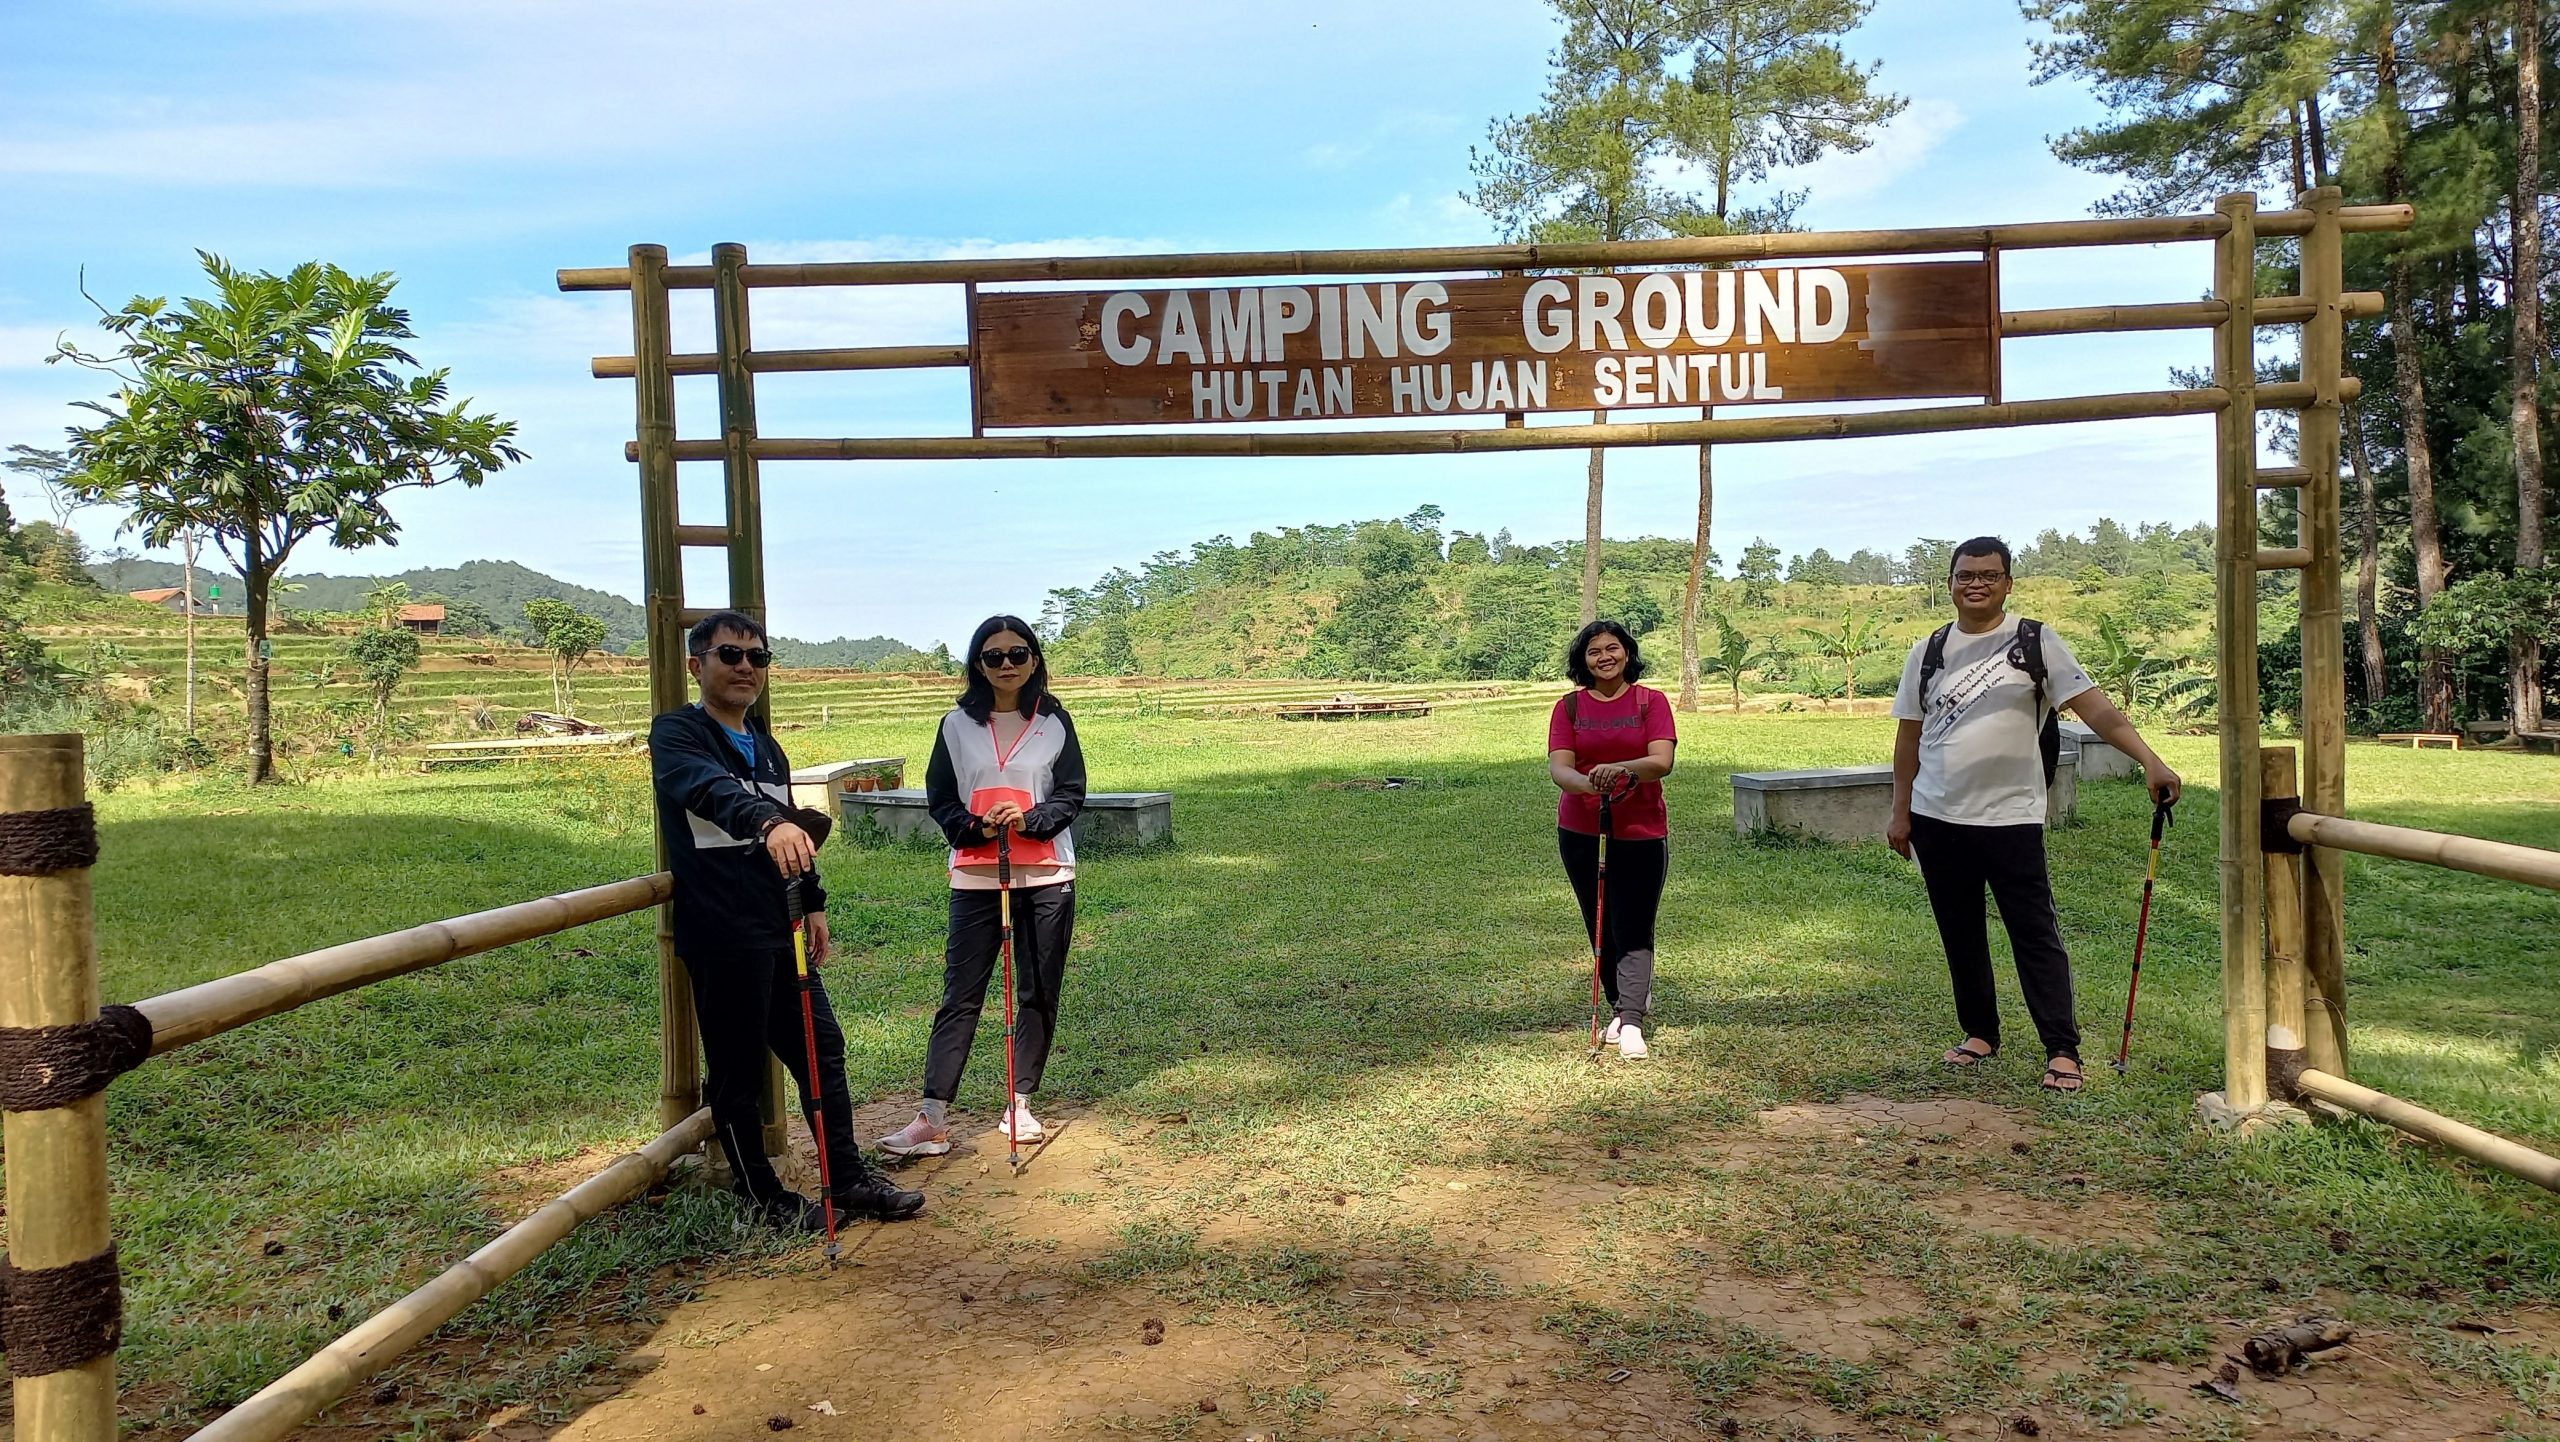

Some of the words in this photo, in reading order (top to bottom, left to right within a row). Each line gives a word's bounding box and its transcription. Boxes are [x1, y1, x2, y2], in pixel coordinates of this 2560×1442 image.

[1101, 282, 1452, 366] CAMPING
[1523, 268, 1850, 354] GROUND
[1192, 366, 1353, 419] HUTAN
[1391, 360, 1546, 414] HUJAN
[1594, 352, 1783, 405] SENTUL
